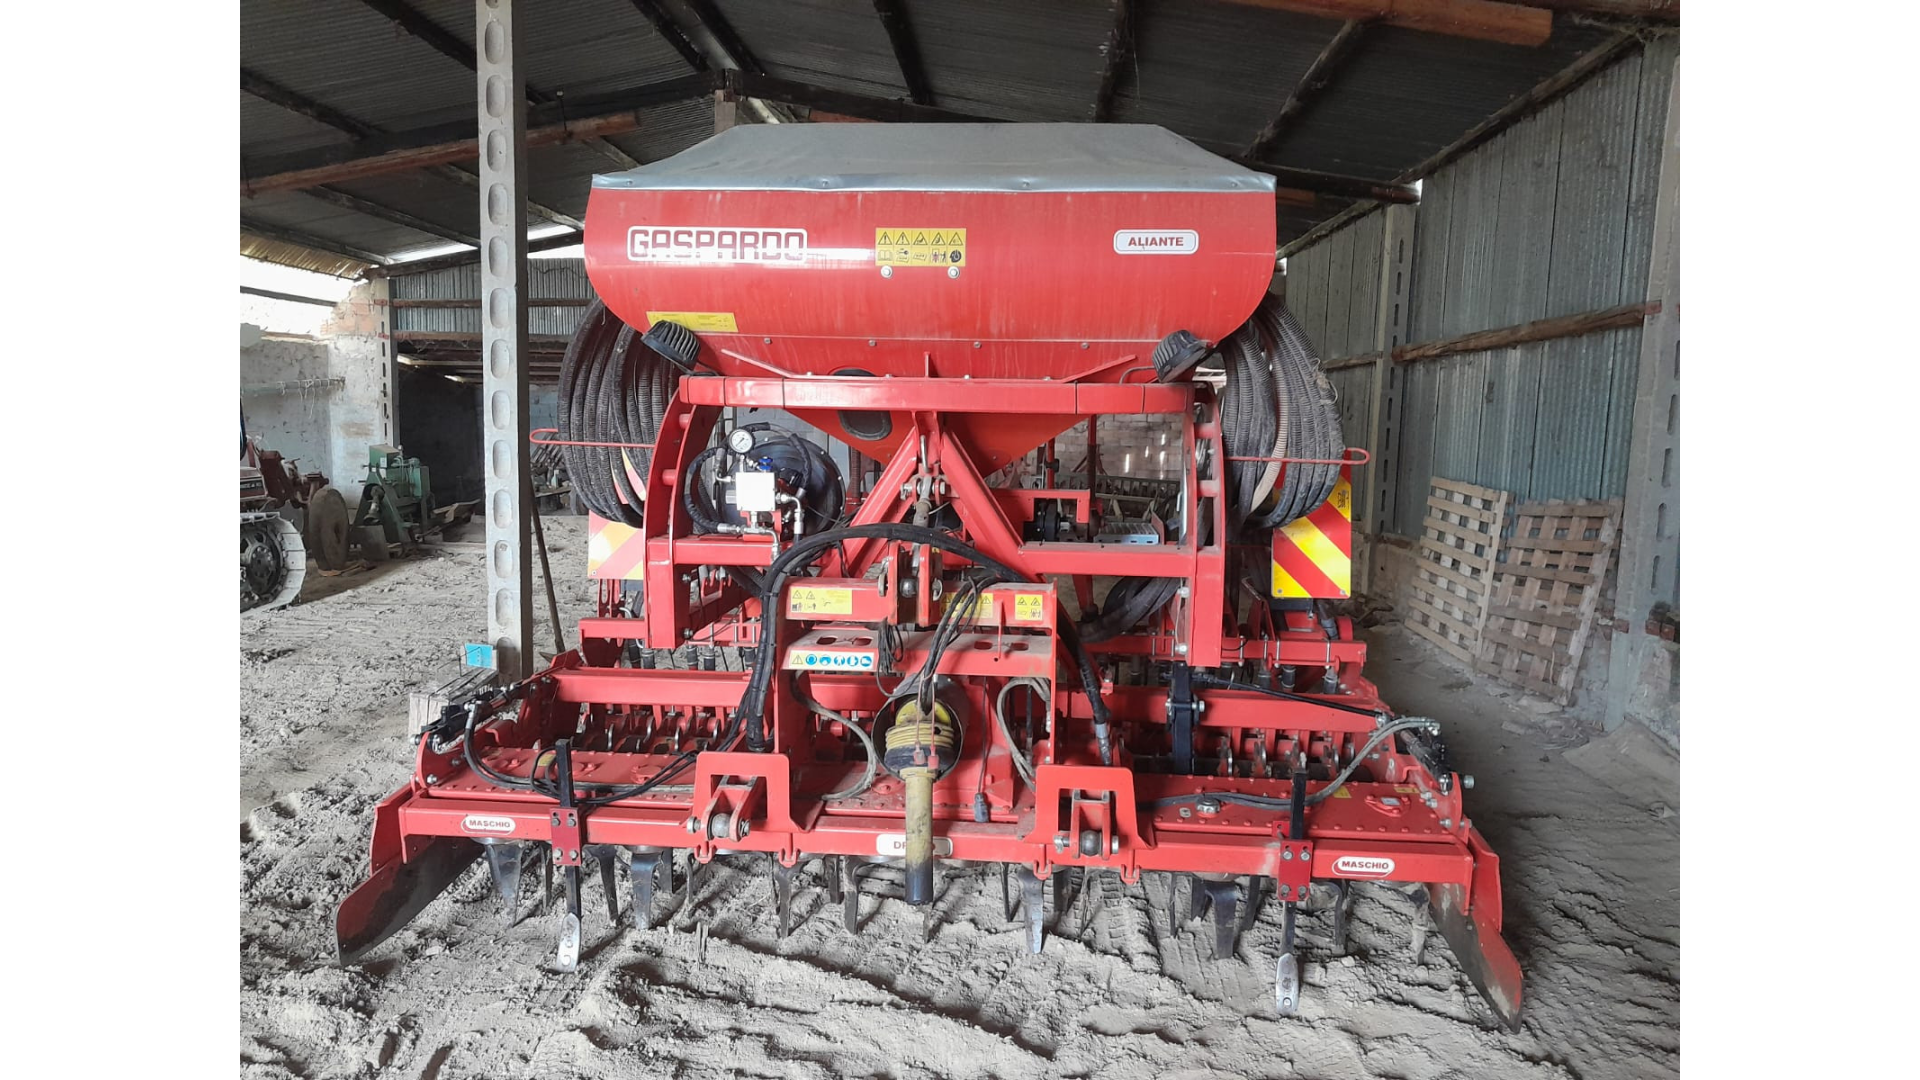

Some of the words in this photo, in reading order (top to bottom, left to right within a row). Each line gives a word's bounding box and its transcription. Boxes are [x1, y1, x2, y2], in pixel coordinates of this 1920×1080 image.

[630, 229, 804, 261] GASPARDO
[1128, 237, 1184, 246] ALIANTE
[469, 819, 511, 828] MASCHIO
[1341, 860, 1389, 869] MASCHIO
